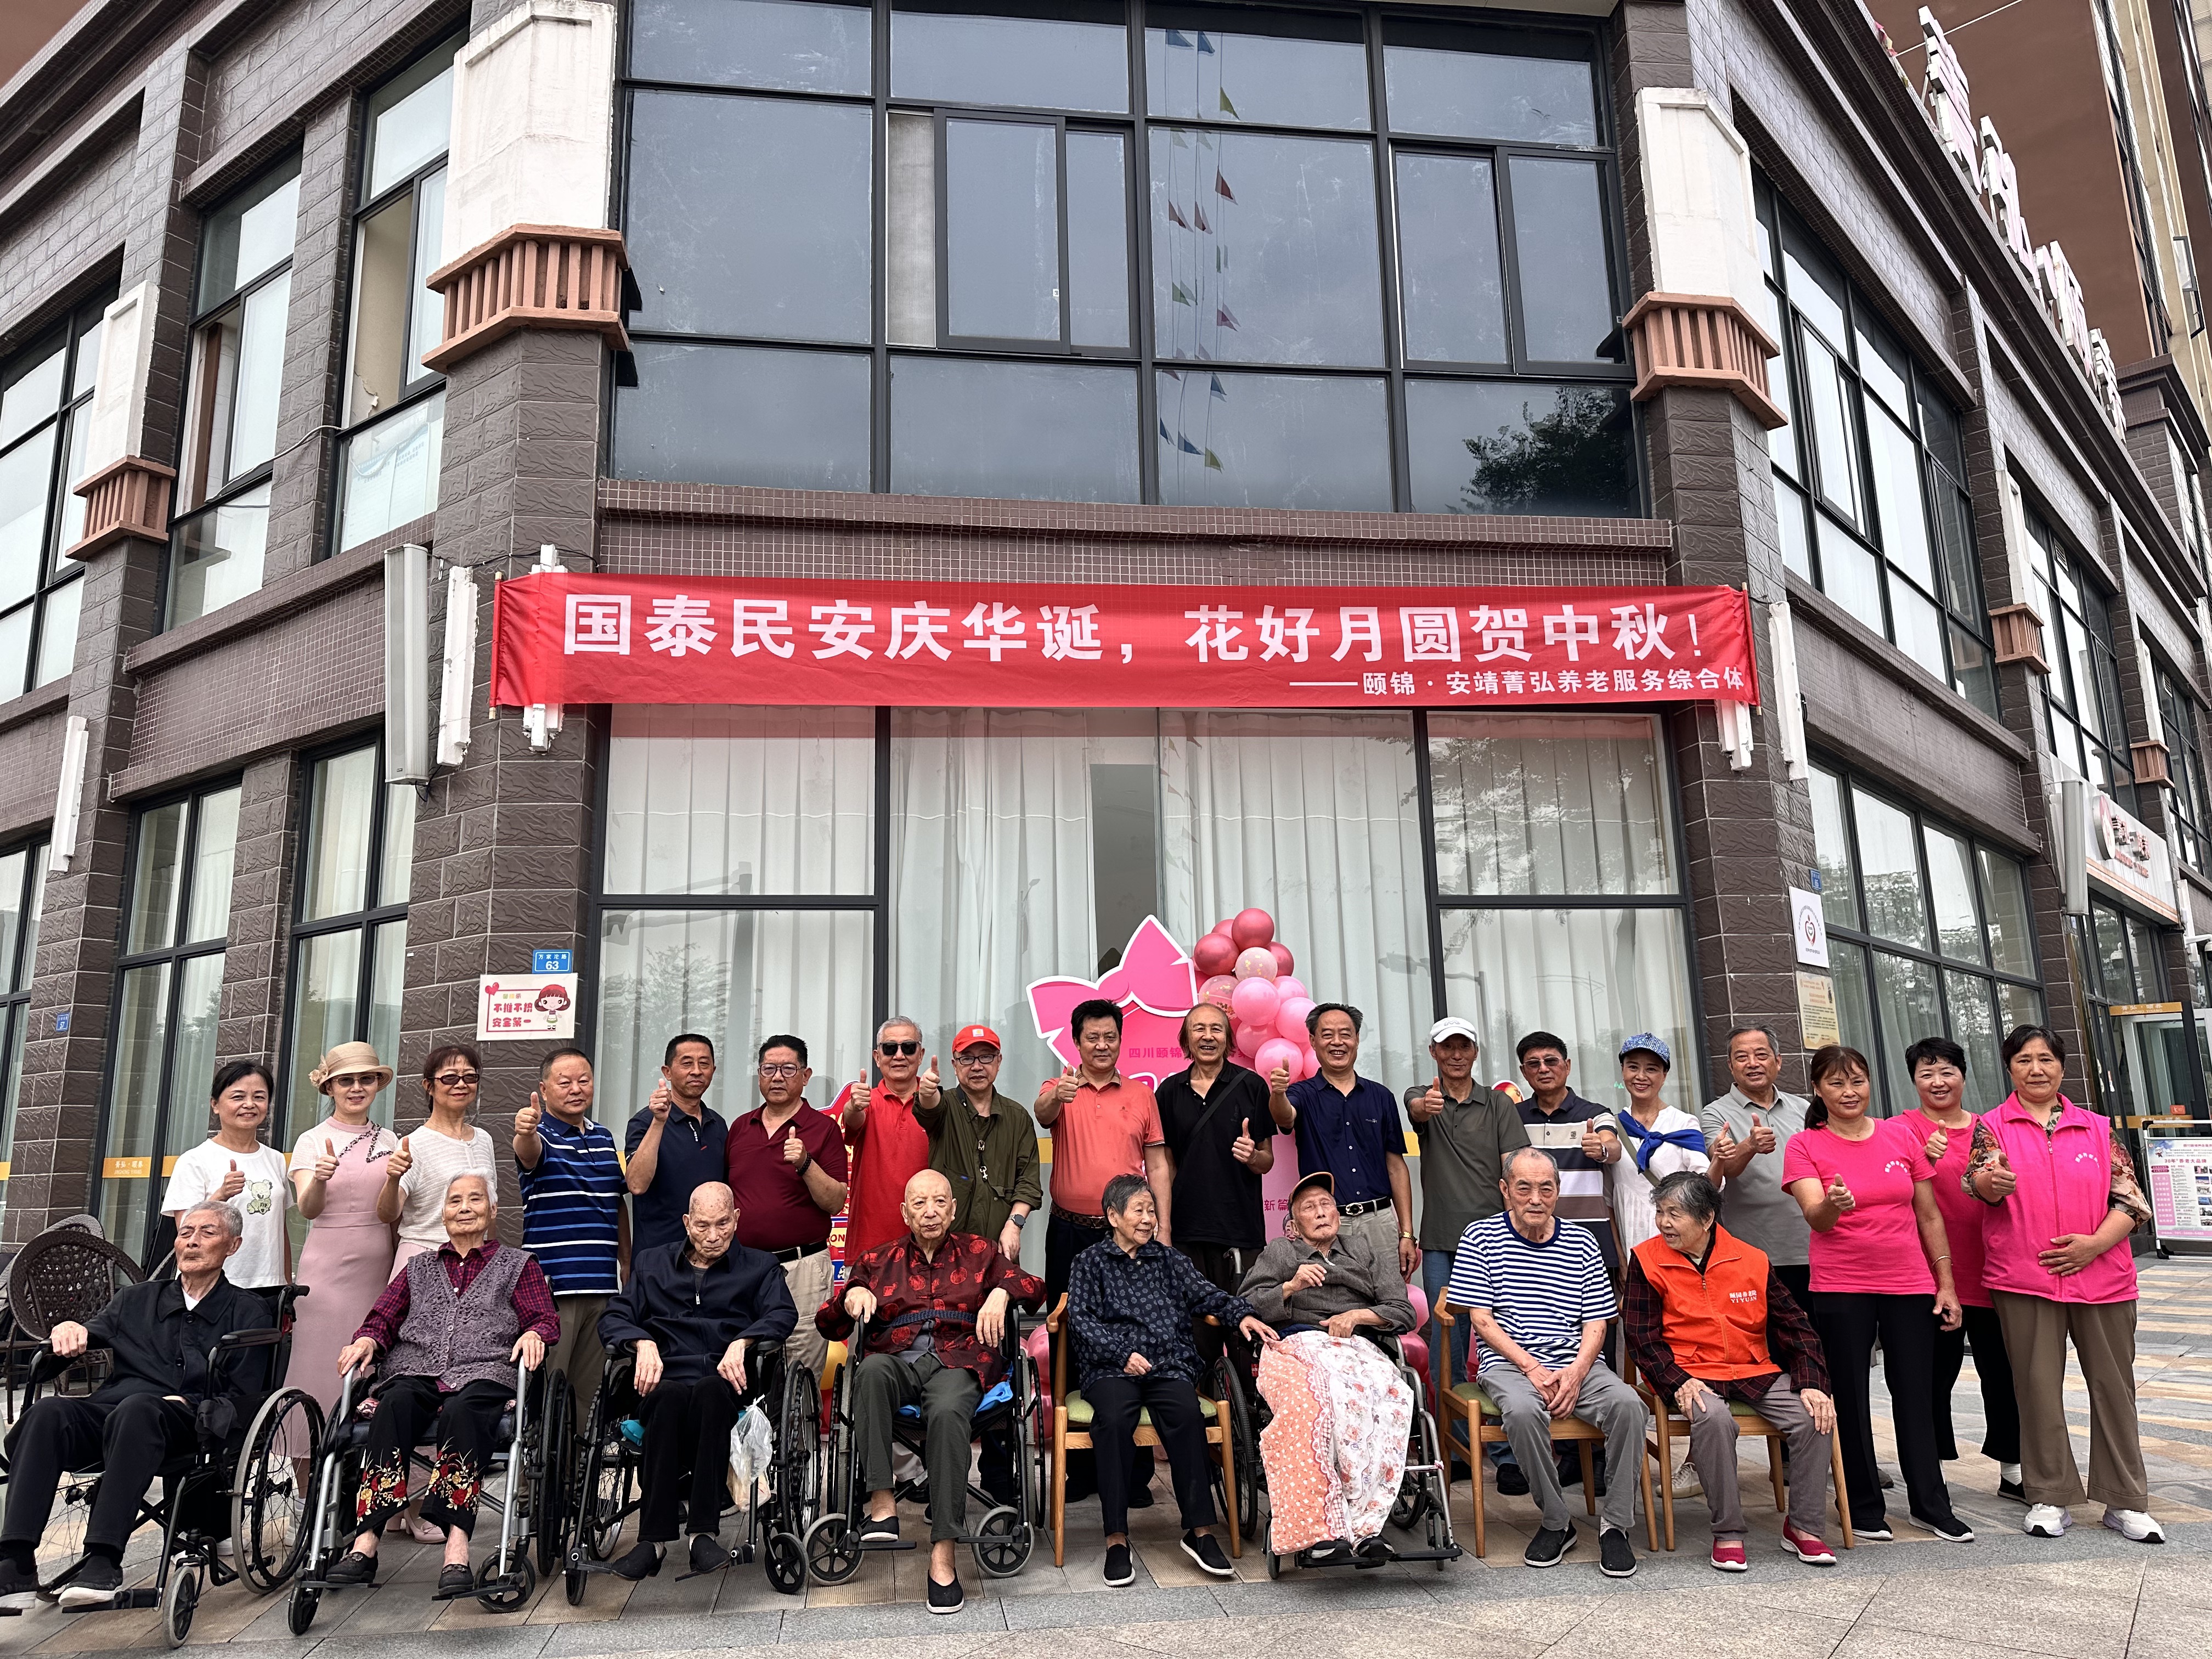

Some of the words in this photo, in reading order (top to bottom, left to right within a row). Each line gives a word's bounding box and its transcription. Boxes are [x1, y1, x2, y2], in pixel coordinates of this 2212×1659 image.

[563, 594, 1701, 664] 国泰民安庆华诞，花好月圆贺中秋！
[545, 961, 559, 970] 63
[492, 1017, 532, 1028] 安全第一
